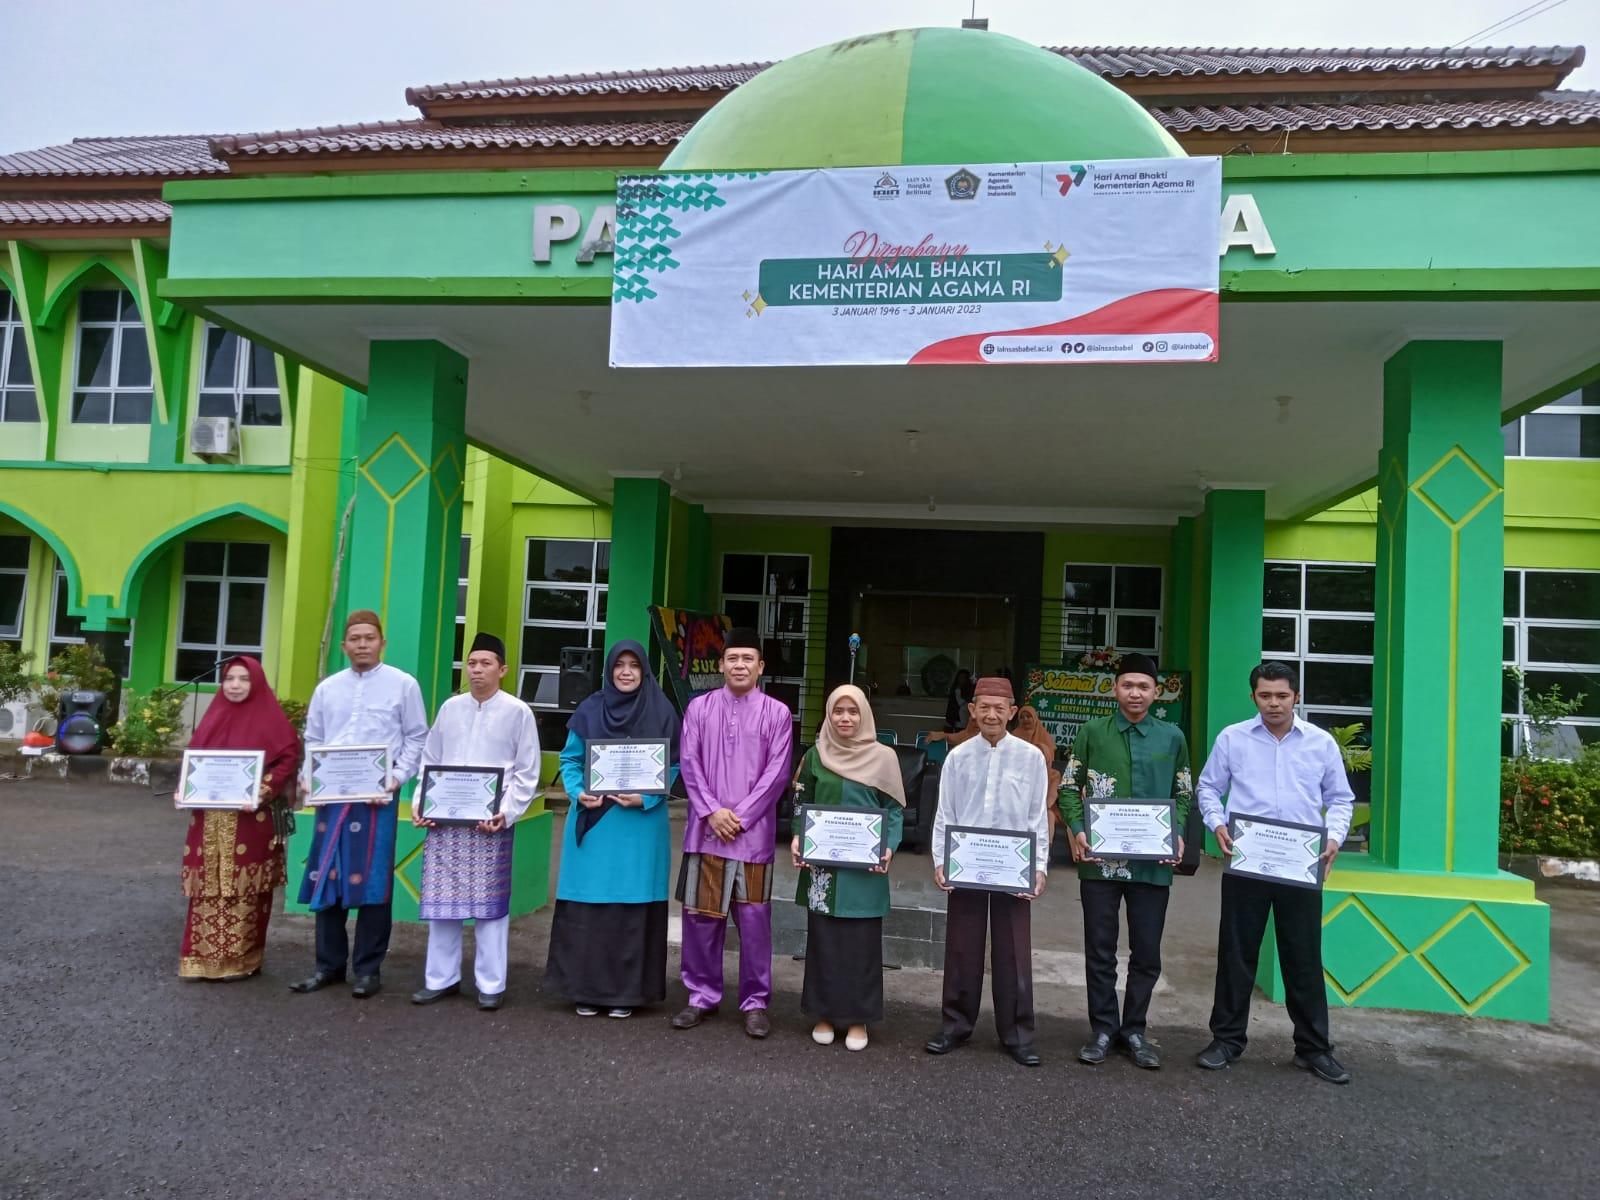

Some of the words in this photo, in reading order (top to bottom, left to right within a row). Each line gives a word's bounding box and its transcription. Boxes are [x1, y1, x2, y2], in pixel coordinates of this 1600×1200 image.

[1094, 173, 1113, 181] Hari
[1114, 171, 1137, 181] Amal
[1139, 170, 1168, 180] Bhakti
[1094, 180, 1150, 190] Kementerian
[1152, 180, 1182, 189] Agama
[843, 231, 969, 270] Dirgahayu
[818, 263, 864, 280] HARI
[869, 262, 924, 279] AMAL
[930, 260, 1002, 278] BHAKTI
[789, 281, 923, 300] KEMENTERIAN
[928, 280, 1005, 298] AGAMA
[1012, 279, 1030, 296] RI
[832, 307, 839, 316] 3
[839, 306, 878, 316] JANUARI
[880, 306, 900, 315] 1946
[908, 305, 916, 315] 3
[916, 304, 956, 315] JANUARI
[957, 304, 982, 314] 2023
[996, 345, 1053, 353] iainsasbabel.ac.id
[1086, 344, 1134, 352] @iainsasbabel
[1171, 342, 1209, 351] @iainbabel
[692, 658, 719, 673] SUK
[1043, 671, 1097, 692] Selamat
